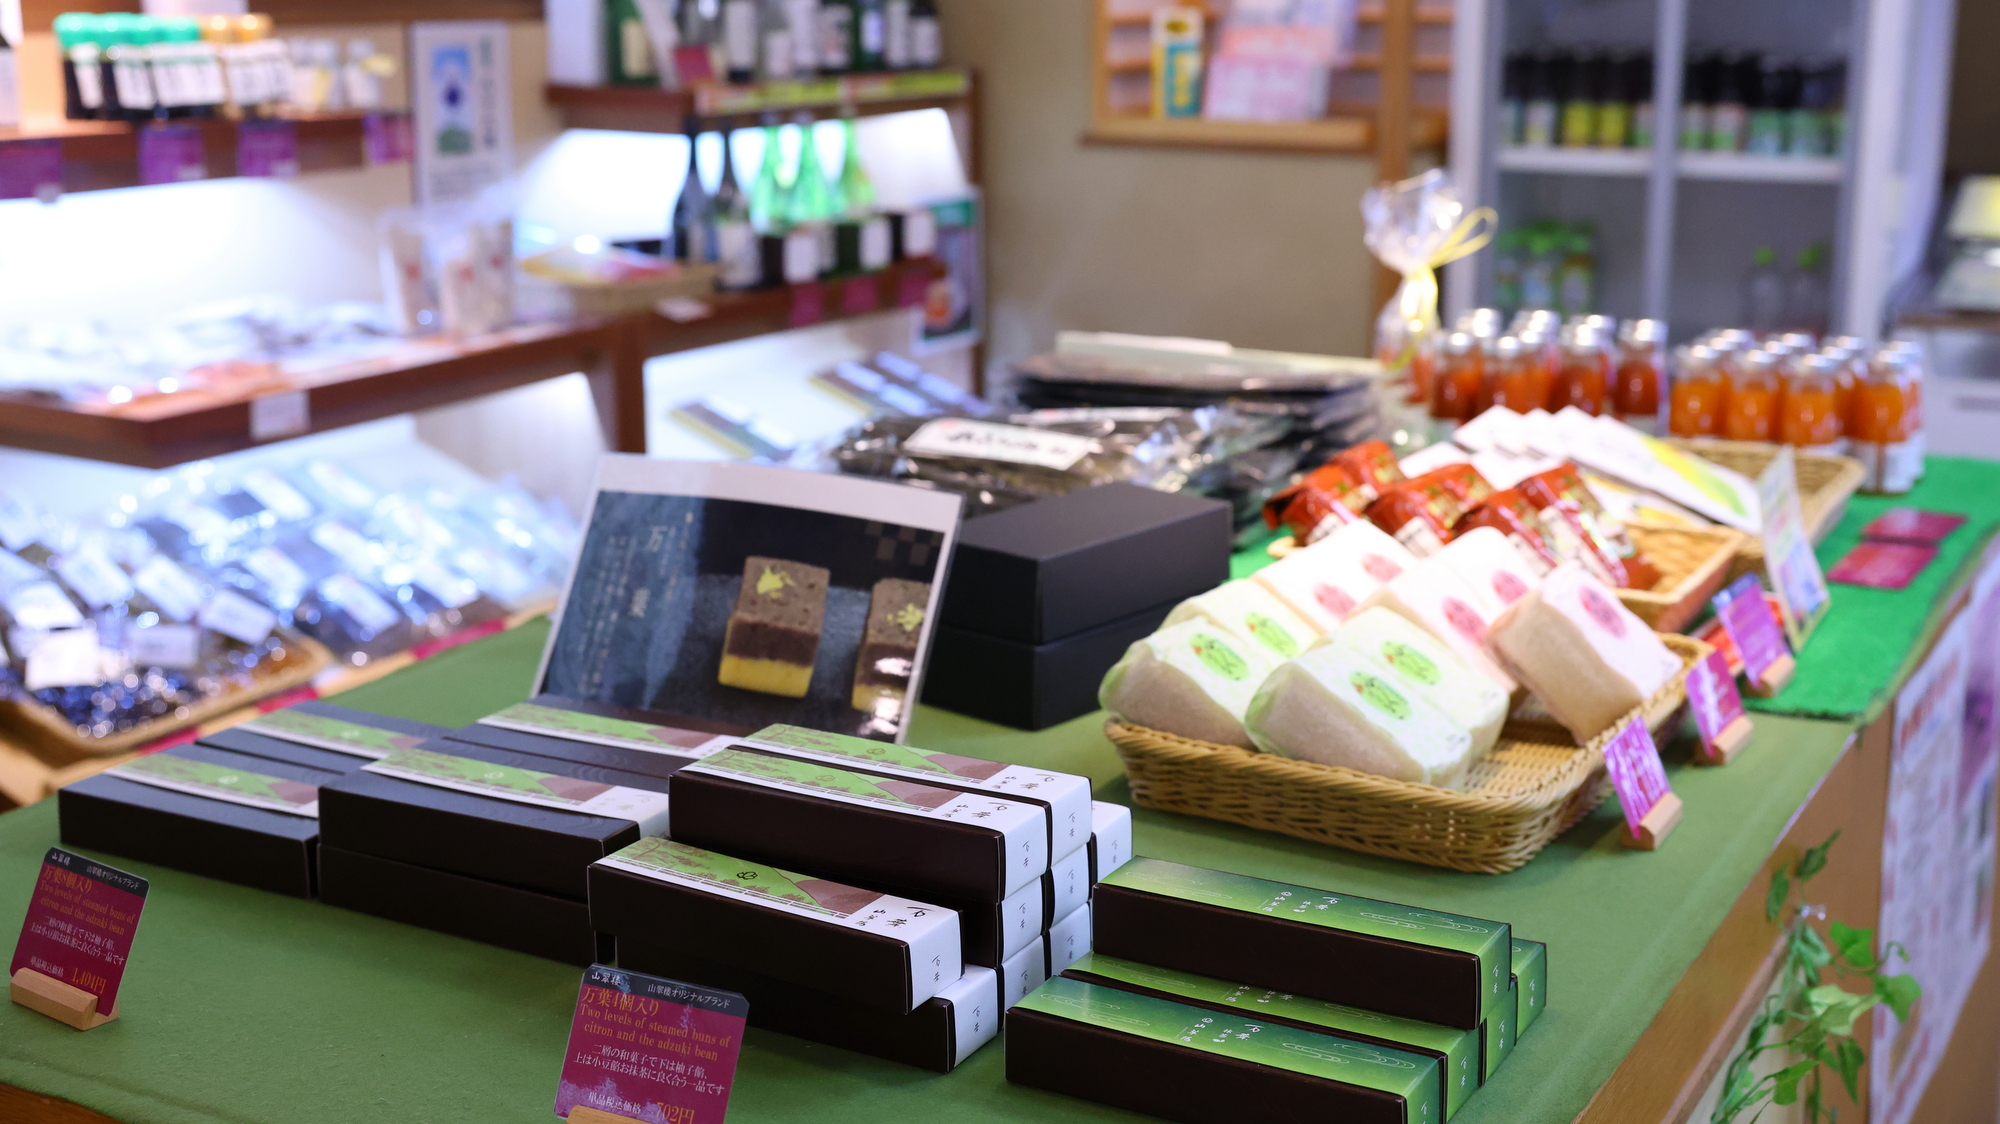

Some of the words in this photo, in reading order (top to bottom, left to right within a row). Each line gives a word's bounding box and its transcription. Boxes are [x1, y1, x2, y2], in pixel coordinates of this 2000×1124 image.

[41, 880, 54, 893] Two
[54, 886, 73, 899] levels
[73, 894, 82, 903] of
[126, 913, 137, 925] of
[60, 905, 74, 916] and
[74, 908, 85, 920] the
[109, 919, 125, 936] bean
[71, 967, 107, 995] 1,404円
[582, 986, 659, 1016] 万葉4個入り
[580, 1003, 600, 1018] Two
[604, 1008, 632, 1026] levels
[635, 1018, 647, 1028] of
[649, 1022, 688, 1038] steamed
[692, 1028, 716, 1044] buns
[719, 1036, 732, 1048] of
[584, 1021, 613, 1037] citron
[616, 1028, 635, 1042] and
[639, 1033, 654, 1046] the
[658, 1039, 692, 1055] adzuki
[695, 1045, 718, 1061] bean
[588, 1091, 642, 1114] 単品税込価格
[655, 1101, 695, 1124] 702円
